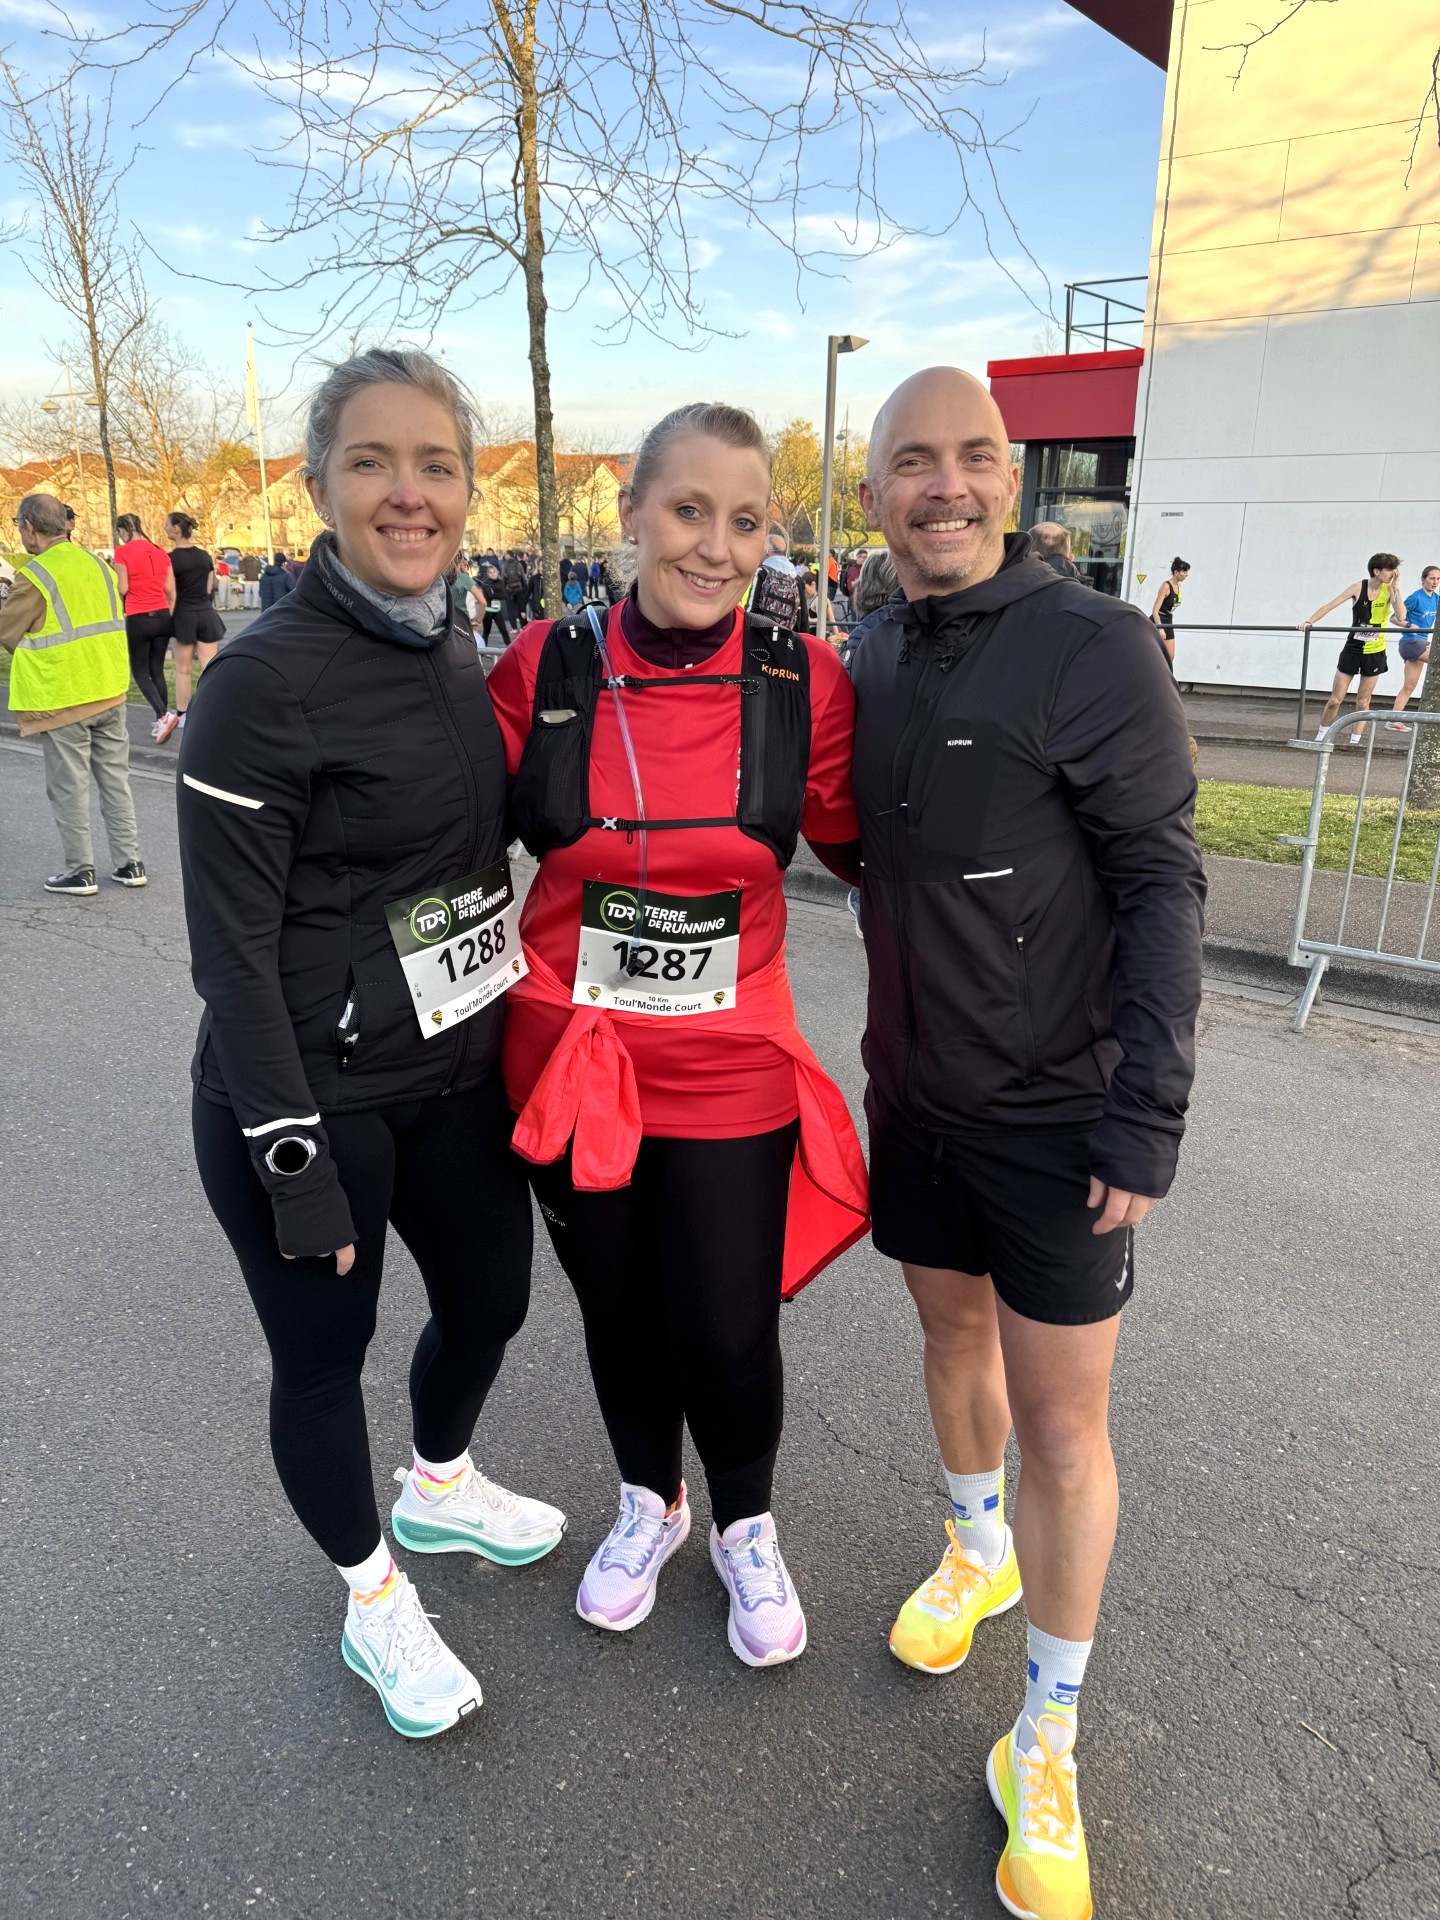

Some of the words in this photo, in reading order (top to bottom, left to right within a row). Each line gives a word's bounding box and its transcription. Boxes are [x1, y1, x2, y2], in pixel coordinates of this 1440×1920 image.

[762, 664, 799, 681] KIPRUN
[450, 886, 483, 912] TERRE
[416, 909, 447, 933] TDR
[607, 902, 636, 922] TDR
[644, 905, 687, 923] TERRE
[437, 919, 506, 983] 1288
[612, 940, 713, 982] 1287
[493, 976, 509, 993] Court
[674, 1002, 702, 1012] Court
